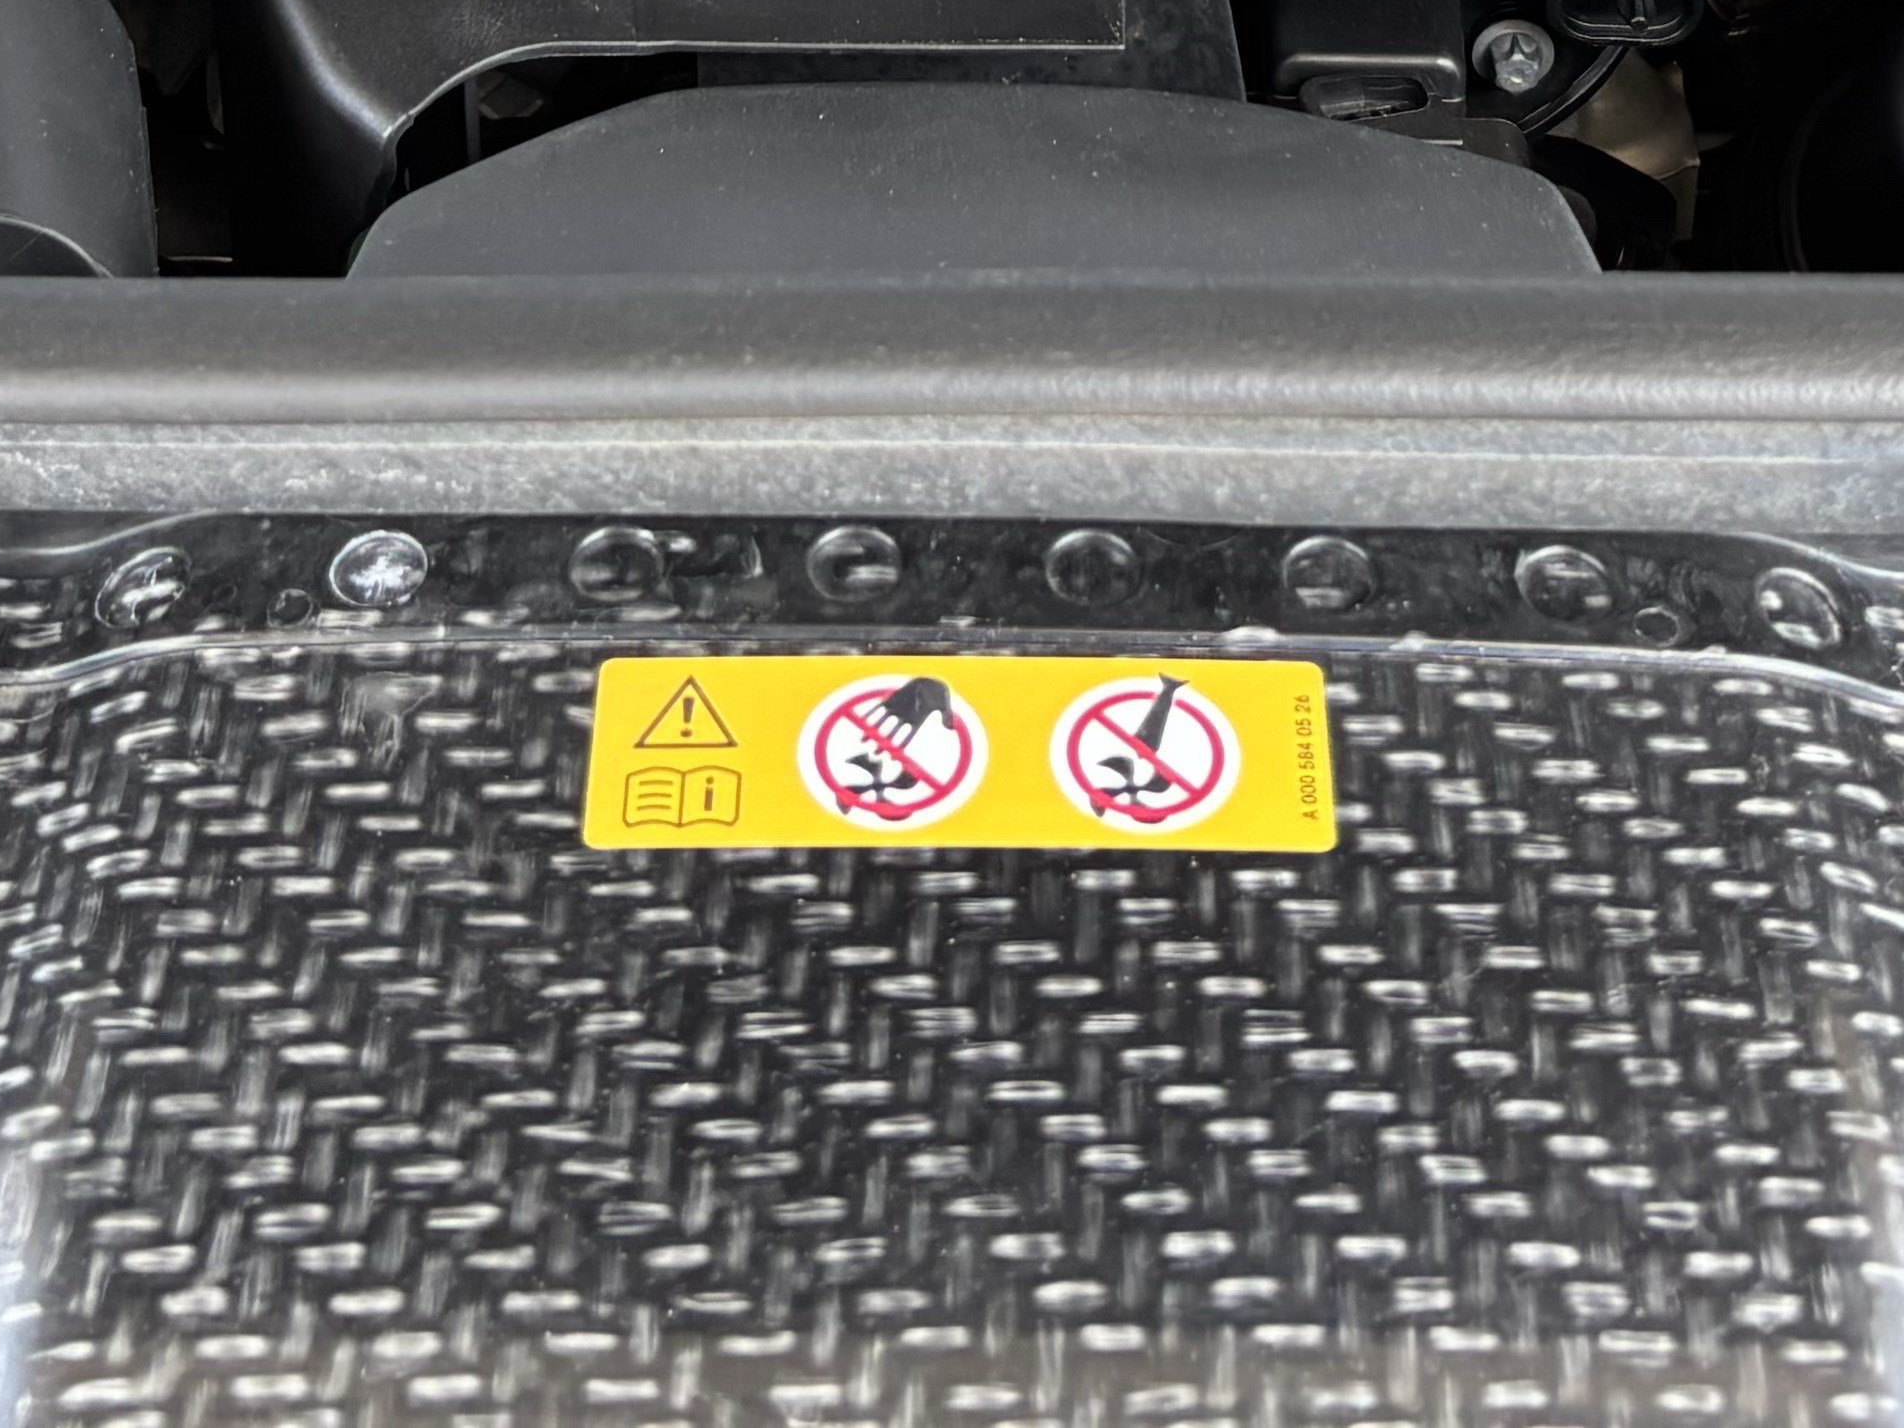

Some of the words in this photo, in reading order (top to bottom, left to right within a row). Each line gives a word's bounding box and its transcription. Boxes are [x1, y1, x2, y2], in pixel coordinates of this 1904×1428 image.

[1295, 718, 1313, 737] 05
[1296, 742, 1316, 770] 584
[1299, 774, 1318, 805] 000
[1301, 809, 1319, 820] A
